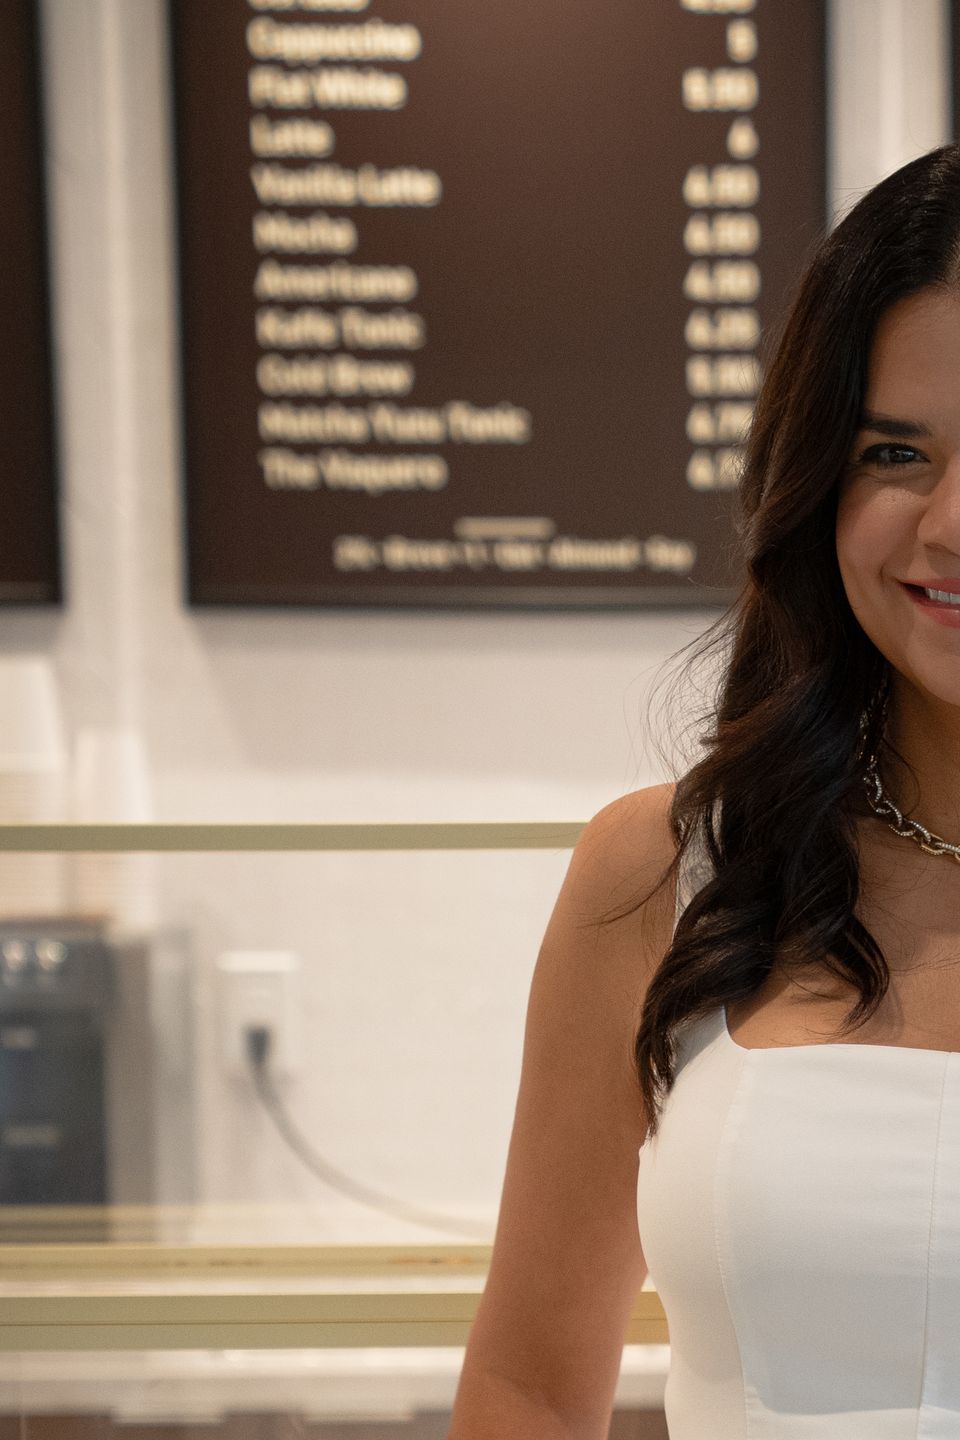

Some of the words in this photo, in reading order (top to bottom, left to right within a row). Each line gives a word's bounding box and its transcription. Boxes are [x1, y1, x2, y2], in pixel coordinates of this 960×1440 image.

[248, 19, 421, 65] Cappuccino
[250, 67, 309, 108] Flat
[312, 67, 407, 109] White
[250, 118, 334, 157] Latte
[251, 166, 358, 206] Vanilla
[359, 165, 441, 206] Latte
[253, 214, 357, 254] Mocha
[254, 261, 417, 301] Americano
[339, 309, 424, 349] Tonic
[257, 356, 331, 396] Cold
[333, 356, 414, 396] Brew
[445, 402, 530, 443] Tonic
[261, 450, 319, 490] The
